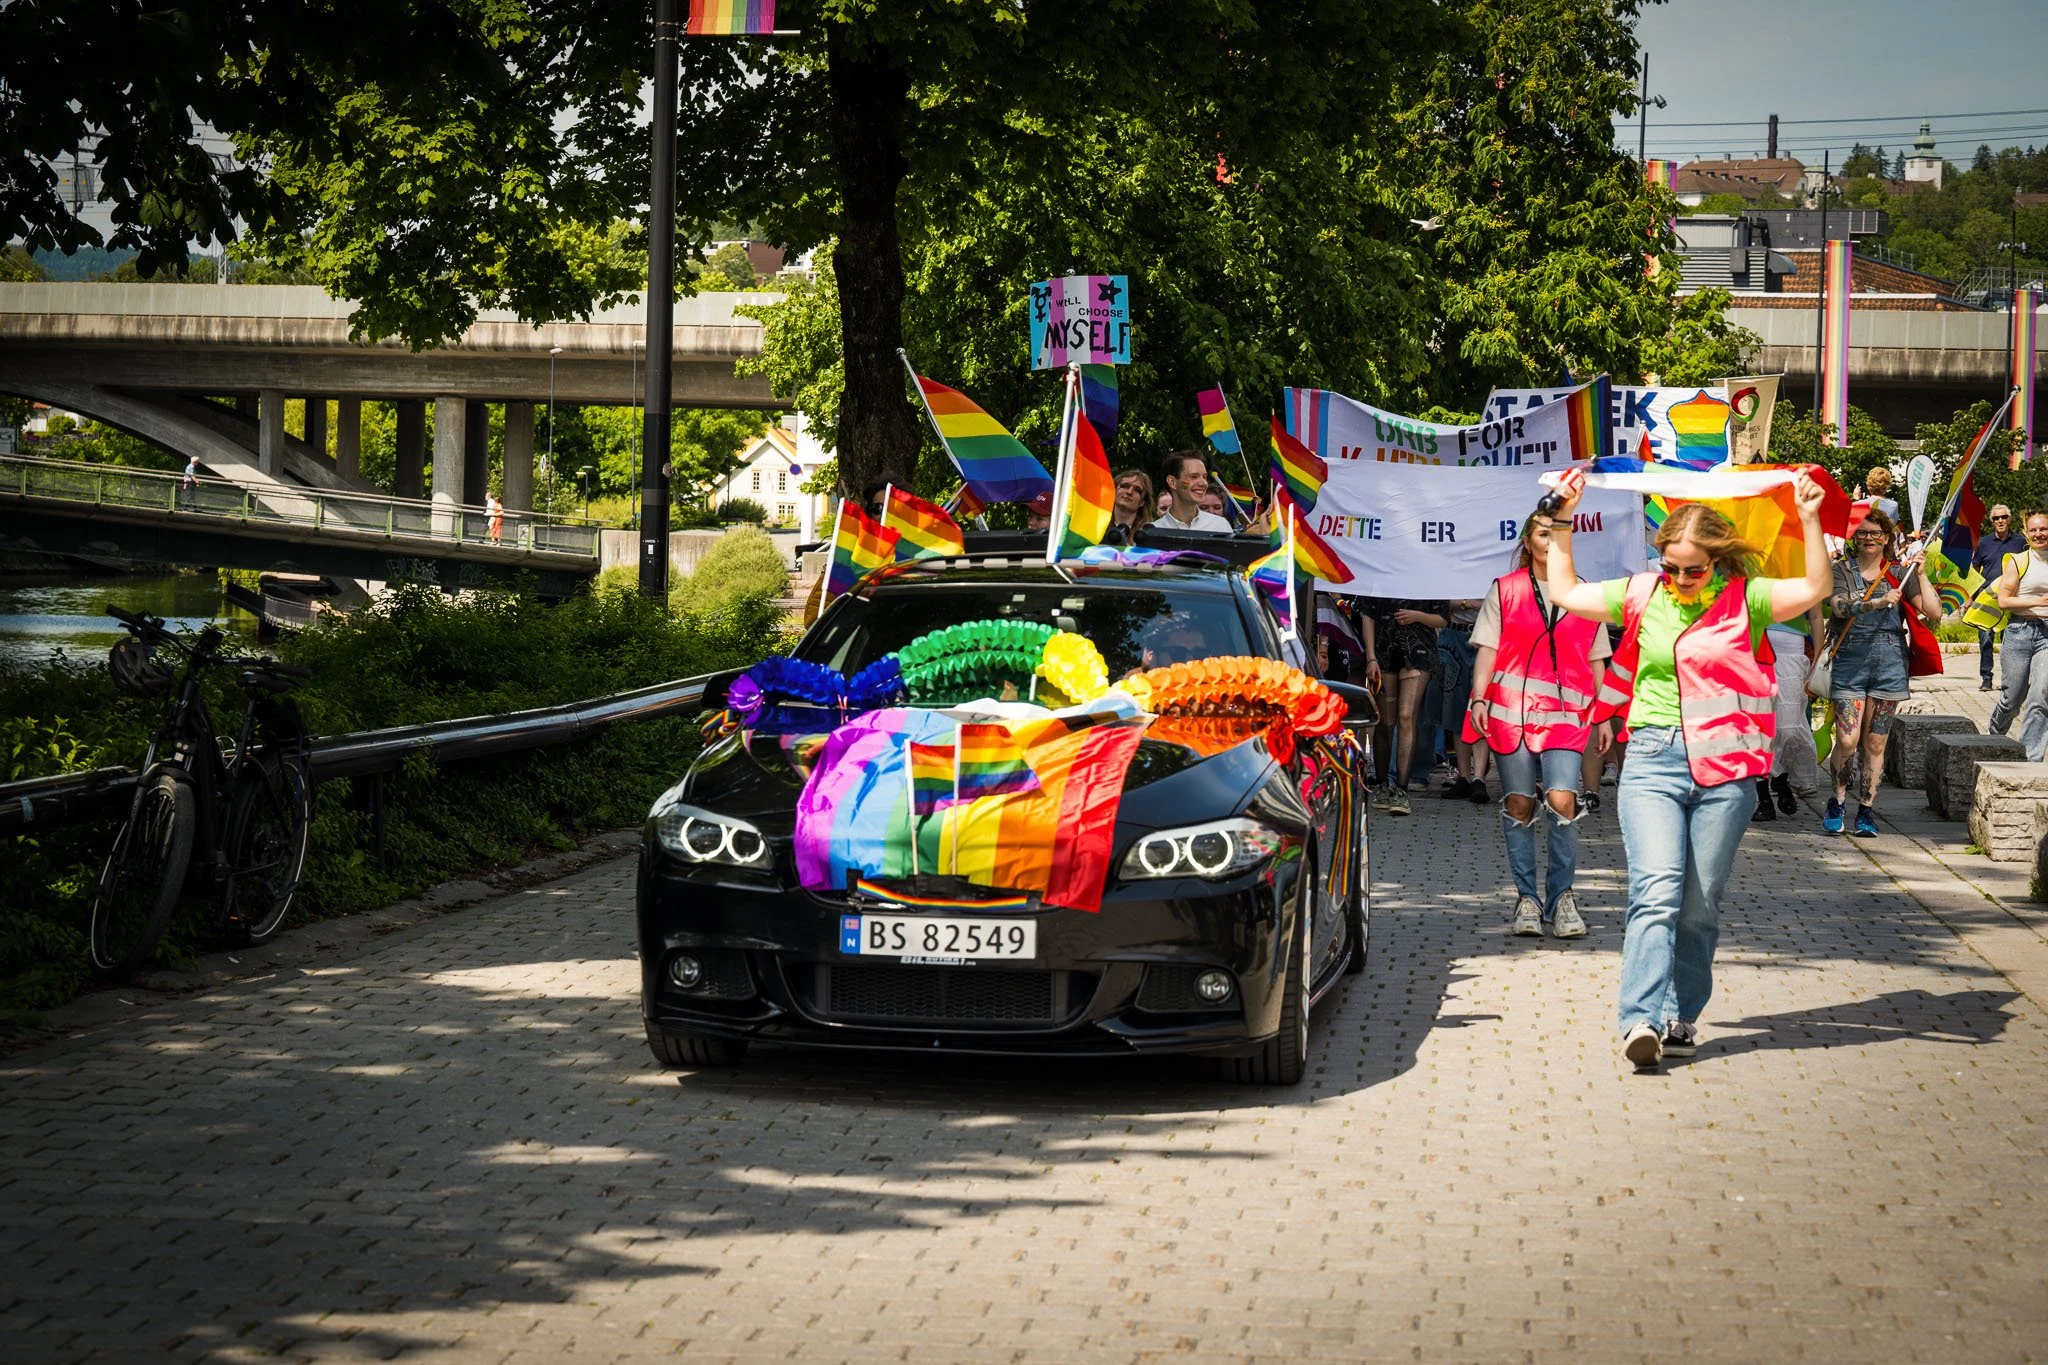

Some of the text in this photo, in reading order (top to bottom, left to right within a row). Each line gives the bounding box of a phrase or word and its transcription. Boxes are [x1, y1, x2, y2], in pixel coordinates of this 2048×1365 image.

[1056, 297, 1081, 308] WILL
[1078, 308, 1123, 318] CHOOSE
[1044, 319, 1129, 354] MYSELF
[1458, 416, 1525, 456] FOR
[1910, 460, 1925, 489] KGB
[1317, 514, 1382, 540] DETTE
[1421, 521, 1456, 543] ER
[846, 938, 856, 948] N
[870, 921, 1025, 954] BS 82549
